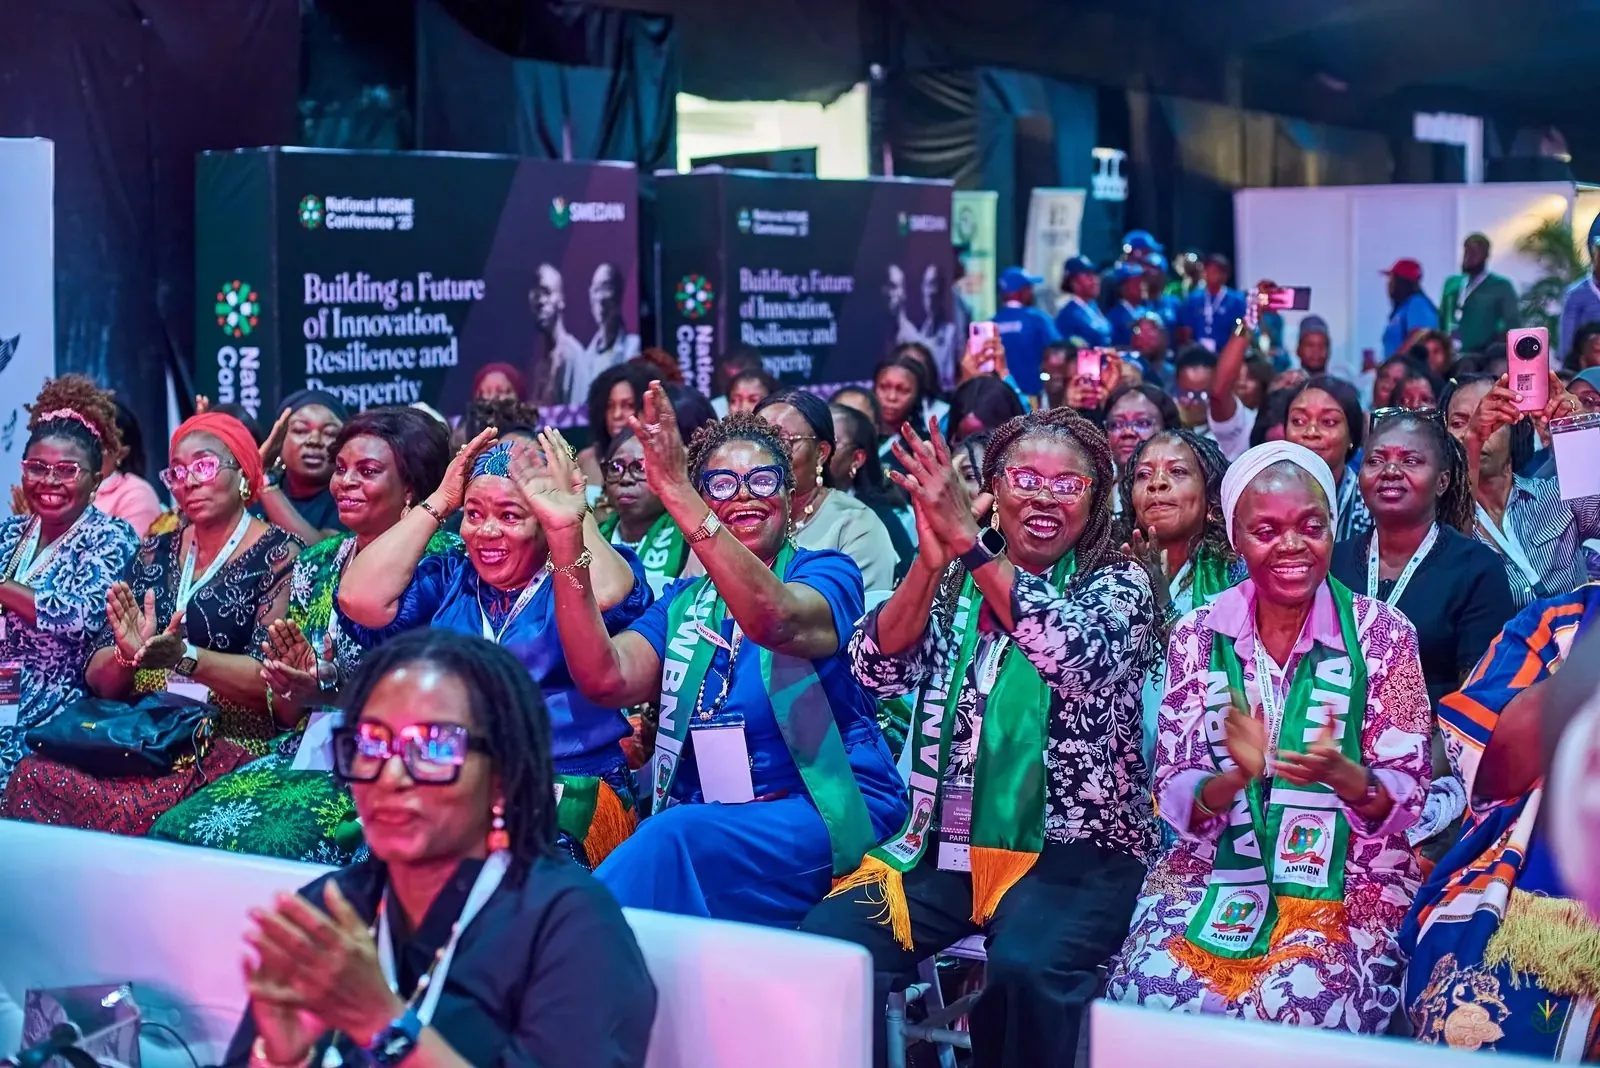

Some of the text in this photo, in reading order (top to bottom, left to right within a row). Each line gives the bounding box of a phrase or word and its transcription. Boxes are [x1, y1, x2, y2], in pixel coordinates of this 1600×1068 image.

[326, 196, 376, 213] National
[569, 201, 625, 222] SMEDAN
[326, 212, 395, 230] Conference
[304, 271, 486, 311] Building a Future
[740, 267, 798, 299] Building
[809, 268, 854, 293] Future
[739, 295, 755, 319] of
[303, 306, 454, 340] of Innovation,
[305, 336, 459, 375] Resilience and
[306, 374, 422, 414] Posperity
[1272, 718, 1281, 745] SMEDAN
[1284, 864, 1320, 876] ANWBN
[1211, 932, 1249, 942] ANWBN
